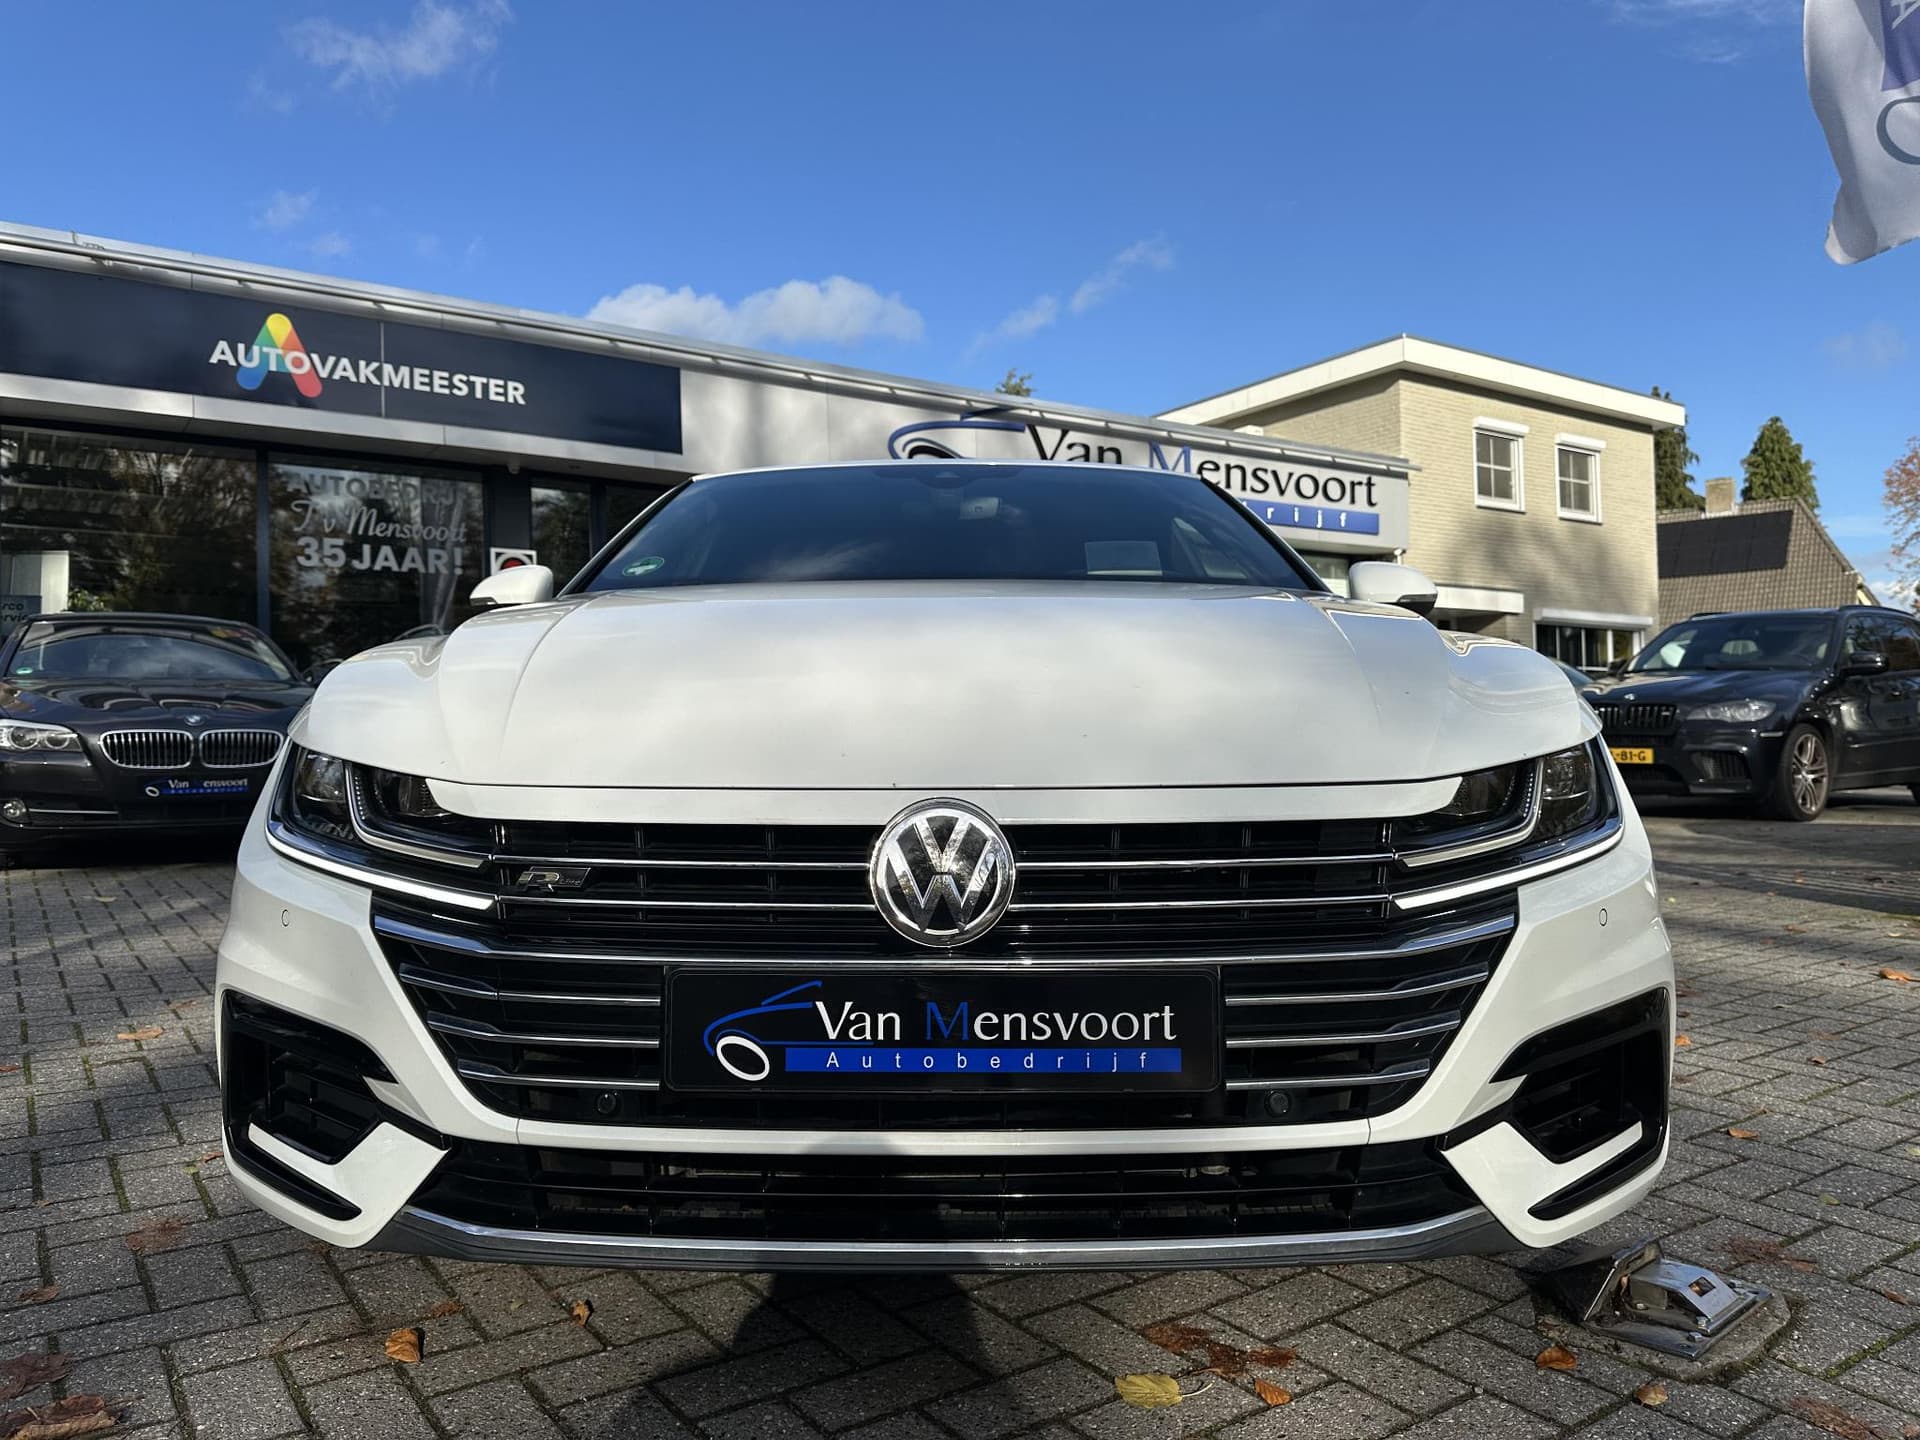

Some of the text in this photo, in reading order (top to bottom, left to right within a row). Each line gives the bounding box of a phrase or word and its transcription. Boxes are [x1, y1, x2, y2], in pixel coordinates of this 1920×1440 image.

[208, 339, 526, 405] AUTOVAKMEESTER
[1027, 423, 1378, 507] Van Mensvoort
[296, 535, 464, 576] 35 JAAR!
[1611, 750, 1646, 761] -81-G
[168, 779, 190, 789] Van
[815, 1000, 1178, 1041] Van Mensvoort
[826, 1051, 1148, 1073] Autobedrijf
